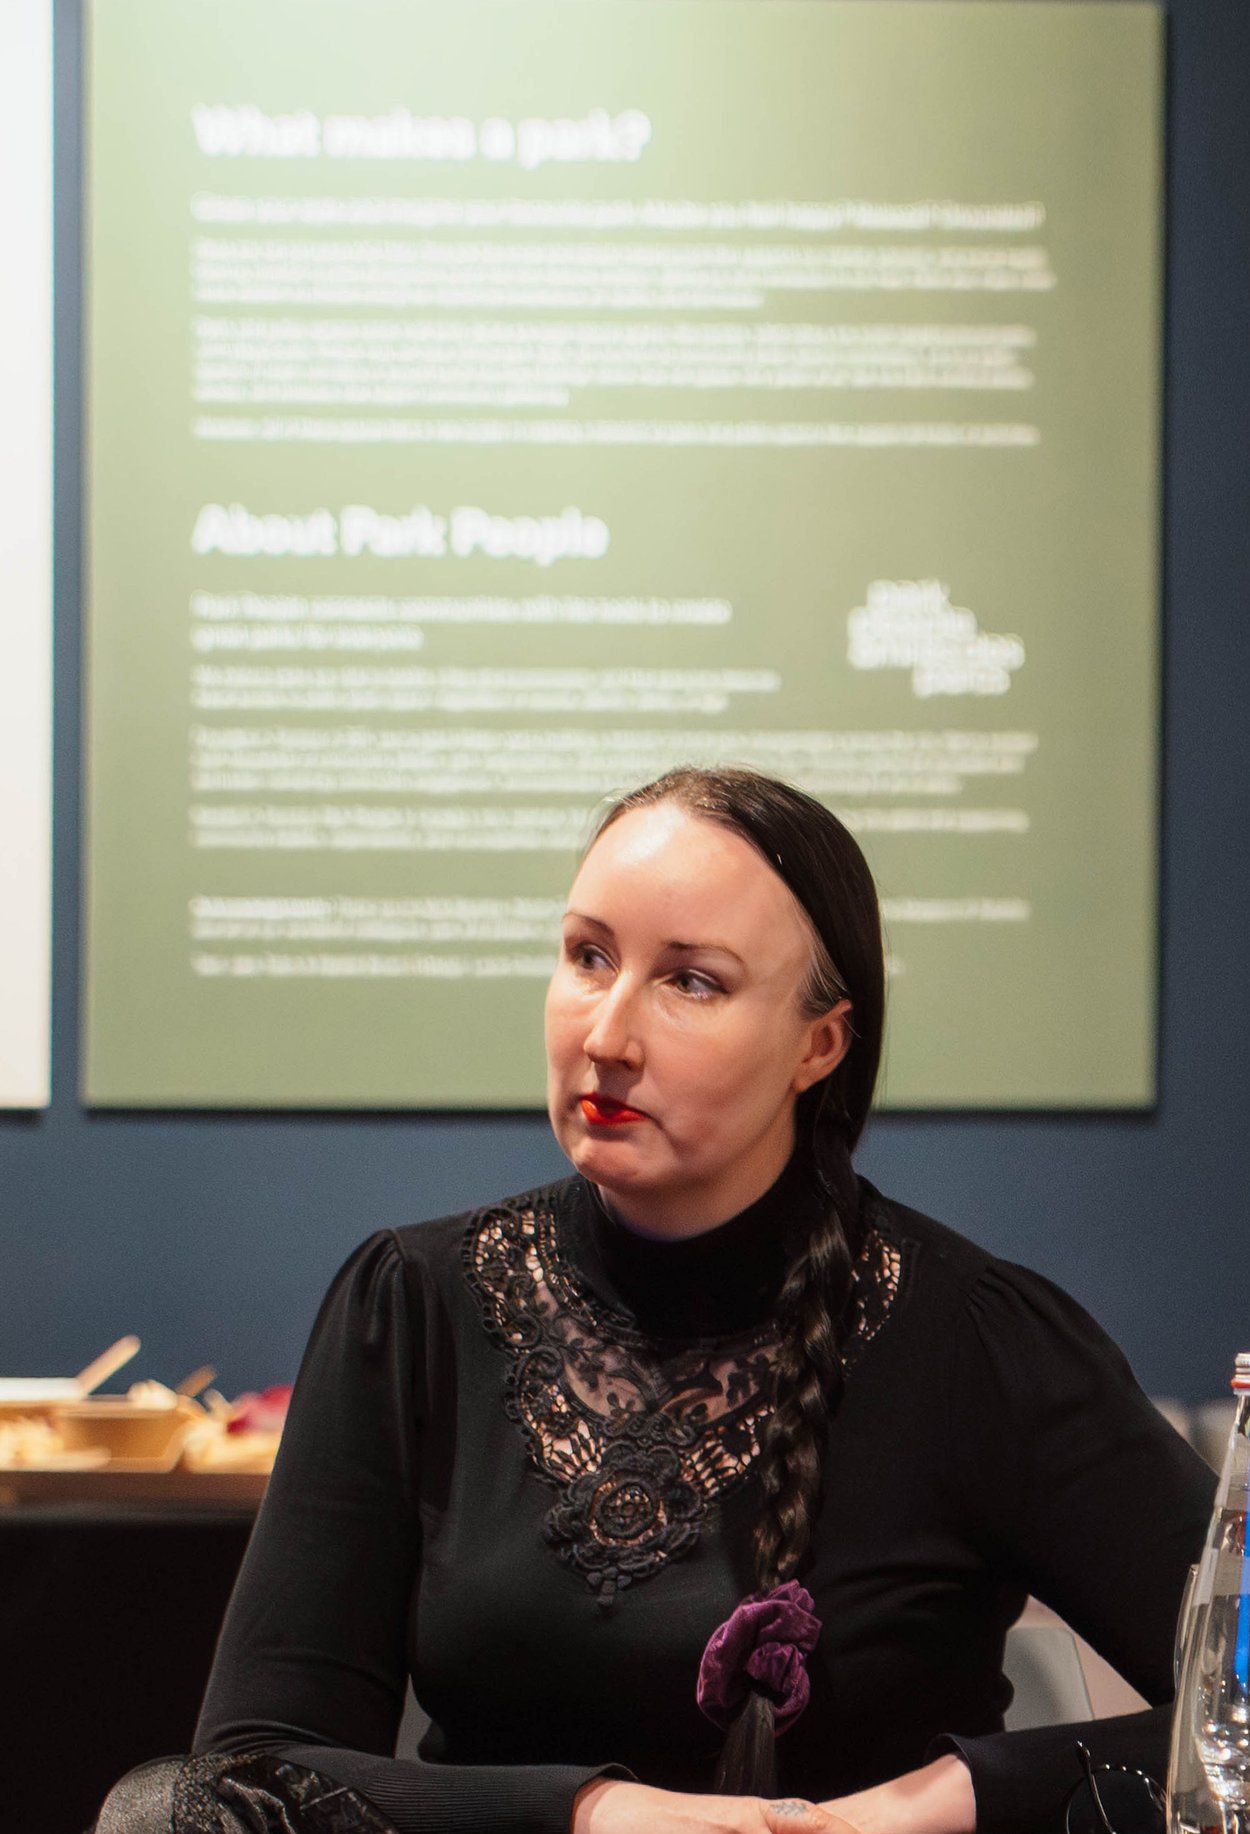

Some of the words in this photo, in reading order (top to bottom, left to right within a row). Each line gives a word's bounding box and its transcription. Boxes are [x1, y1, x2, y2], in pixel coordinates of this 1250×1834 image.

[193, 104, 320, 156] What
[324, 107, 476, 159] makes
[480, 118, 514, 160] a
[518, 109, 651, 169] park?
[193, 504, 337, 555] About
[340, 505, 447, 556] Park
[451, 506, 609, 565] People
